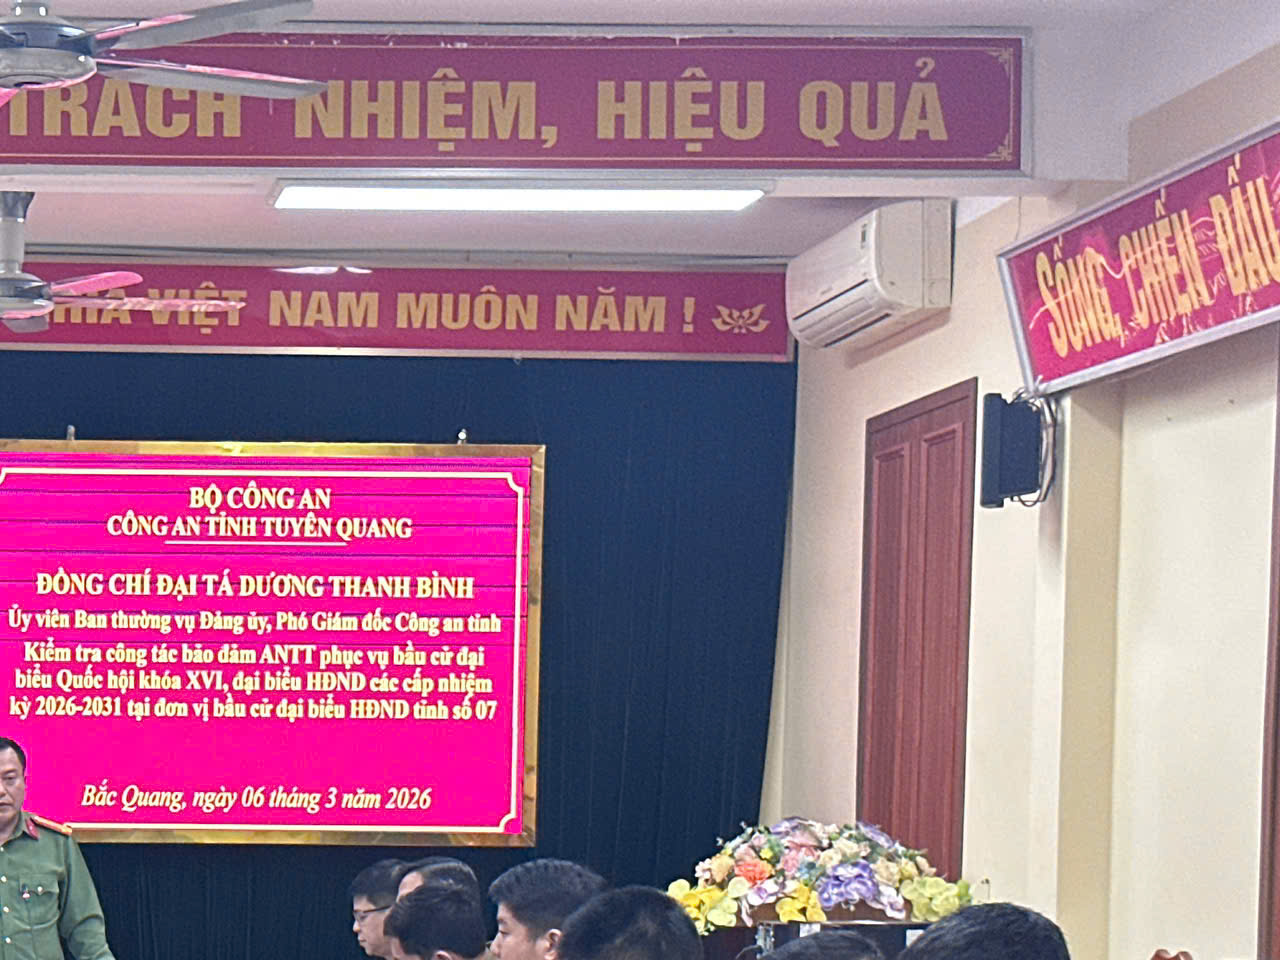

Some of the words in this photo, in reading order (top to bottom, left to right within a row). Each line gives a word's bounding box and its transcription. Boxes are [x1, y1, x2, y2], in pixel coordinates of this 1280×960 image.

[294, 67, 558, 152] NHIỆM,
[597, 67, 765, 152] HIỆU
[798, 57, 948, 148] QUẢ
[1119, 188, 1213, 329] CHIẾN
[148, 281, 247, 334] VIỆT
[268, 290, 379, 328] NAM
[395, 285, 538, 331] MUÔN
[555, 286, 666, 332] NĂM
[682, 297, 696, 332] !
[189, 483, 222, 514] BỘ
[226, 480, 295, 509] CÔNG
[298, 488, 331, 509] AN
[107, 510, 168, 537] CÔNG
[171, 516, 201, 537] AN
[205, 511, 257, 538] TỈNH
[261, 511, 332, 538] TUYÊN
[335, 518, 413, 542] QUANG
[108, 567, 151, 595] CHÍ
[156, 574, 197, 601] ĐẠI
[201, 568, 234, 596] TÁ
[239, 571, 324, 598] DƯƠNG
[329, 576, 411, 598] THANH
[416, 570, 474, 599] BÌNH
[8, 603, 32, 632] Ủy
[36, 608, 70, 628] viên
[75, 610, 107, 628] Ban
[111, 609, 171, 634] thường
[174, 615, 196, 633] vụ
[199, 610, 244, 634] Đảng
[276, 611, 308, 631] Phó
[312, 611, 358, 631] Giám
[361, 607, 392, 631] đốc
[395, 611, 440, 636] Công
[442, 617, 464, 632] an
[467, 613, 502, 632] tỉnh
[24, 637, 71, 662] Kiểm
[75, 645, 102, 662] tra
[105, 642, 147, 667] công
[151, 644, 178, 663] tác
[182, 644, 213, 663] bảo
[217, 644, 256, 663] đảm
[259, 644, 316, 664] ANTT
[320, 646, 363, 669] phục
[367, 650, 389, 670] vụ
[456, 646, 484, 671] đại
[15, 663, 52, 689] biểu
[56, 664, 103, 692] Quốc
[107, 670, 135, 694] hội
[139, 669, 181, 690] khóa
[186, 670, 229, 693] XVI,
[232, 671, 260, 695] đại
[264, 666, 301, 691] biểu
[307, 672, 366, 691] HĐND
[370, 673, 399, 692] các
[402, 668, 434, 697] cấp
[438, 673, 493, 695] nhiệm
[35, 696, 121, 717] 2026-2031
[127, 696, 151, 722] tại
[154, 697, 188, 717] đơn
[192, 697, 209, 722] vị
[276, 698, 304, 723] đại
[308, 694, 345, 718] biểu
[350, 699, 410, 719] HĐND
[452, 693, 472, 719] số
[475, 700, 497, 720] 07
[81, 779, 117, 806] Bắc
[121, 784, 187, 812] Quang,
[192, 786, 238, 811] ngày
[241, 786, 265, 808] 06
[269, 786, 320, 814] tháng
[324, 787, 337, 808] 3
[341, 788, 381, 809] năm
[385, 786, 432, 809] 2026
